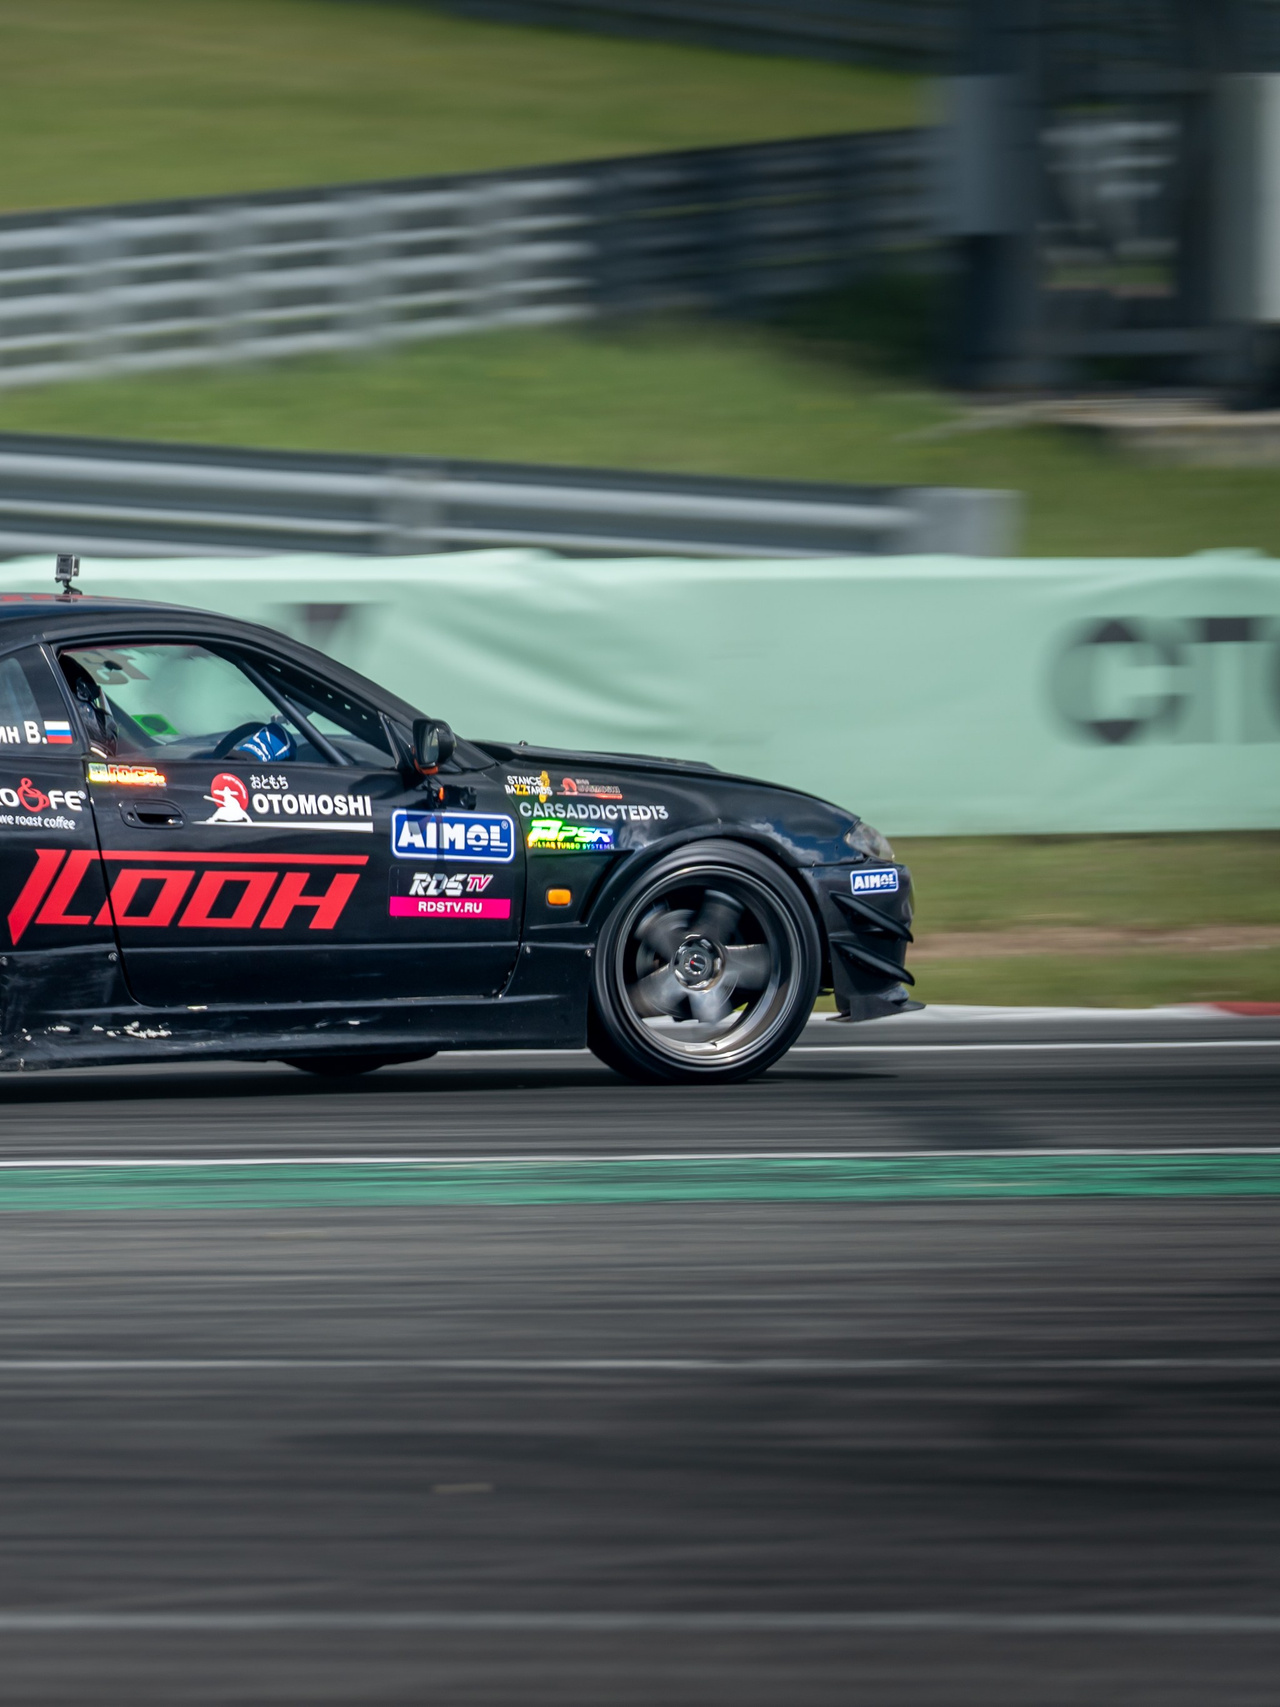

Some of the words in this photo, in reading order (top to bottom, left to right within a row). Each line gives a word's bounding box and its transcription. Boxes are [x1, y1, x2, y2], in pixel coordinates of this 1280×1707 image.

[250, 774, 289, 790] おともち
[507, 775, 543, 787] STANCE
[504, 784, 553, 796] BAZZTARDS
[252, 793, 373, 816] OTOMOSHI
[519, 801, 669, 820] CARSADDICTED13
[15, 816, 43, 827] roast
[43, 816, 76, 830] coffee
[397, 820, 508, 853] AIMOL
[557, 841, 581, 850] TURBO
[854, 874, 896, 889] AIMOL
[418, 901, 483, 914] RDSTV.RU
